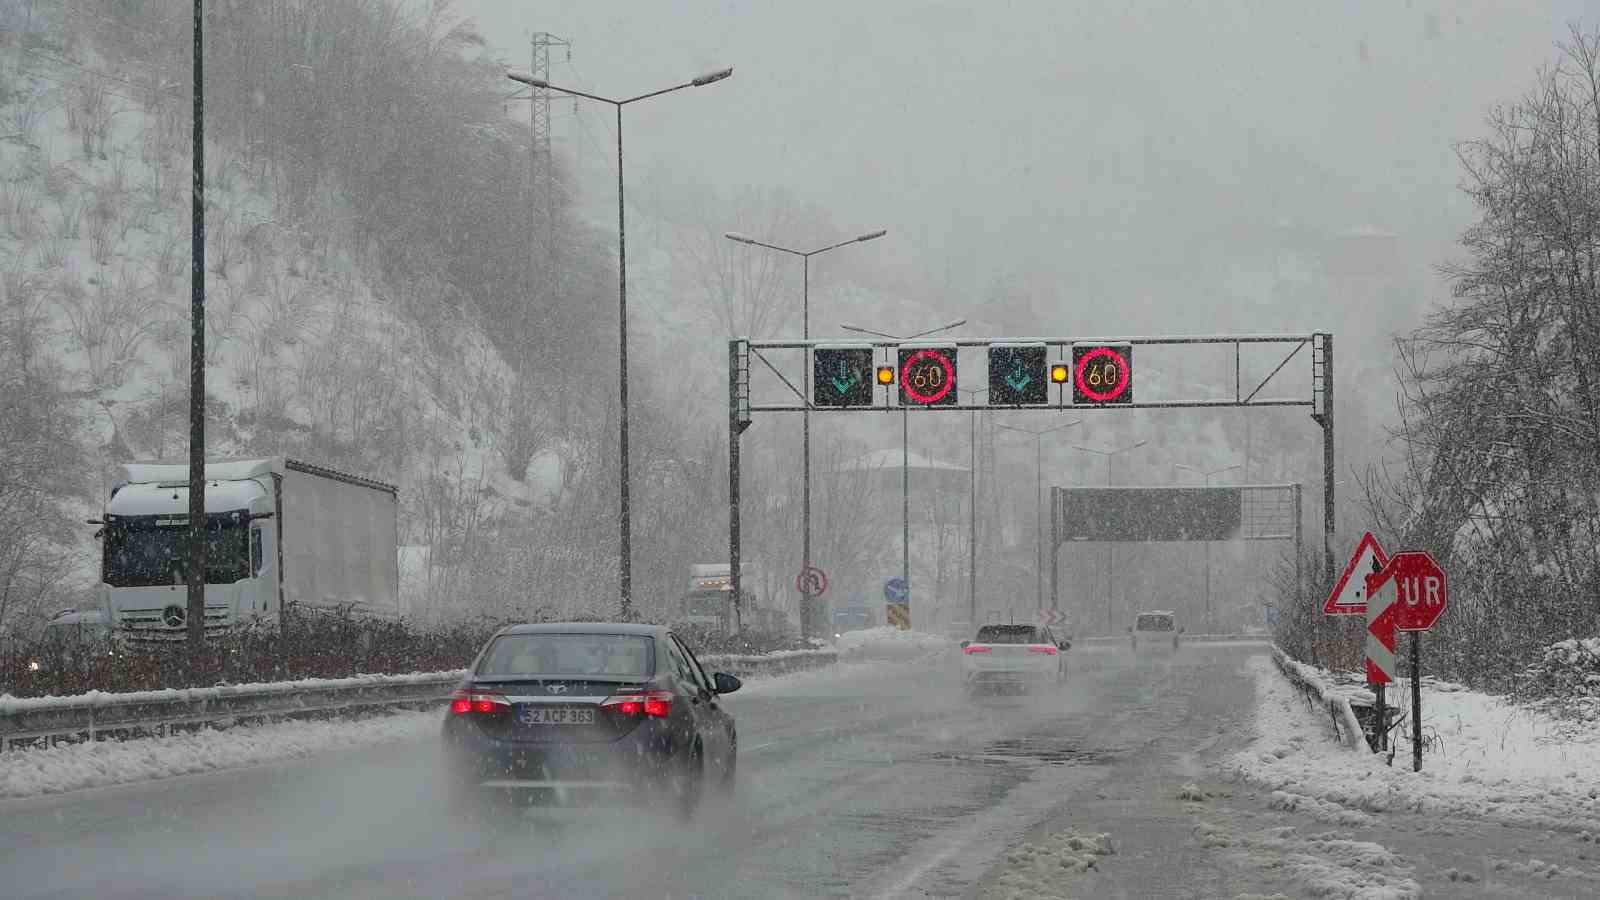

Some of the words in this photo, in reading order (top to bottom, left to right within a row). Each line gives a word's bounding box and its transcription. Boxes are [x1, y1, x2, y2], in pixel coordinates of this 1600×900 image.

[914, 366, 941, 387] 60
[1090, 364, 1116, 385] 60
[1393, 576, 1441, 606] UR
[569, 709, 593, 723] 363
